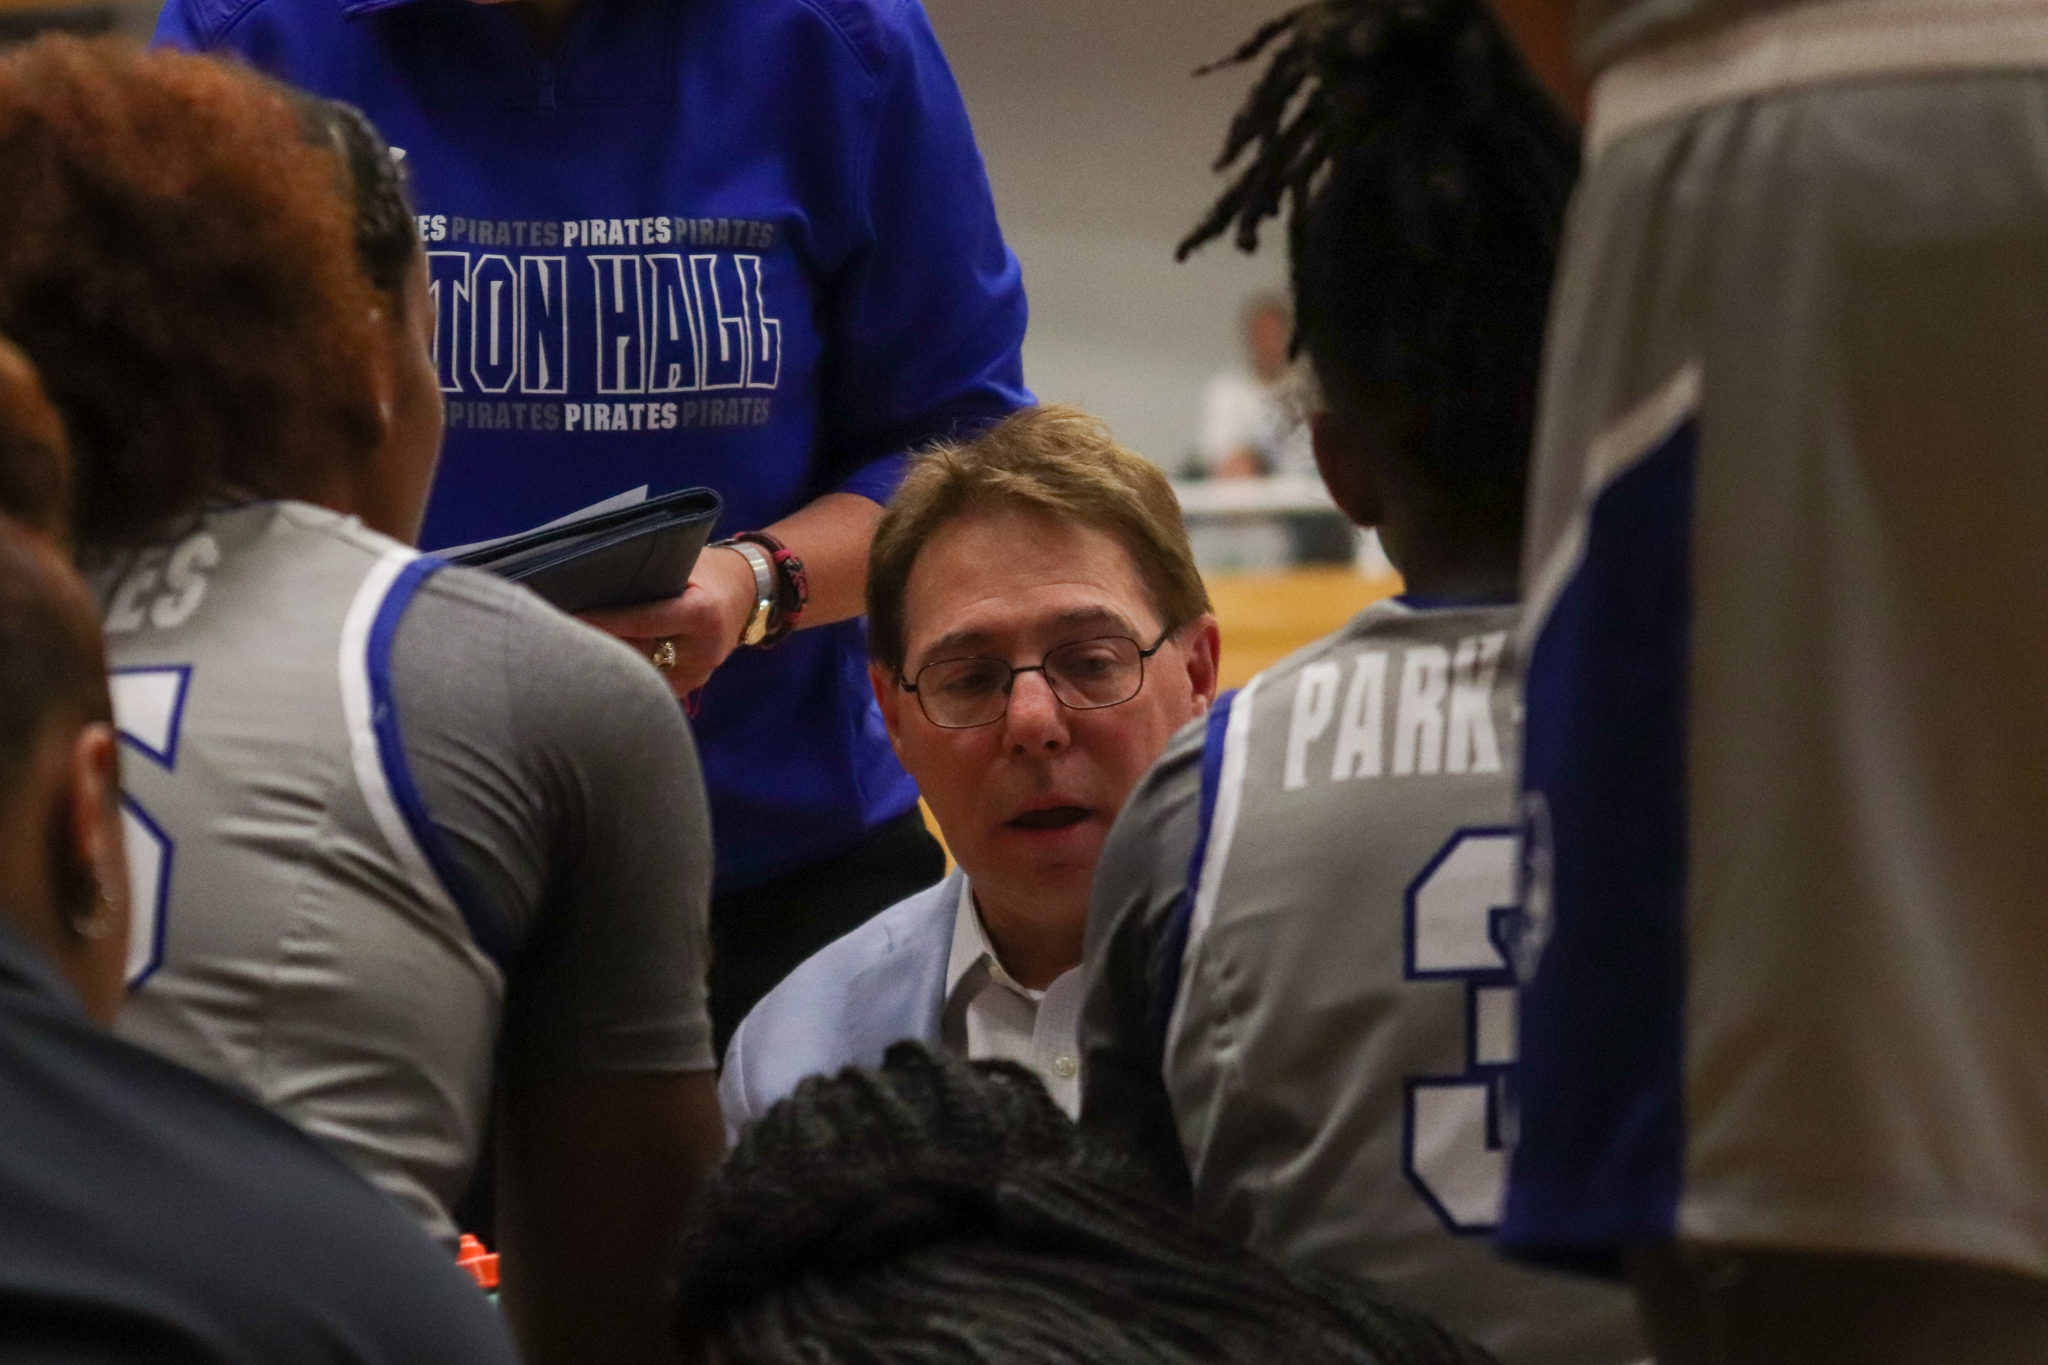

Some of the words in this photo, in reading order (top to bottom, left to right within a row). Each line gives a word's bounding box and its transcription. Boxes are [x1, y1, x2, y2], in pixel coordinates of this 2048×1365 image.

[414, 214, 447, 242] ES
[452, 216, 558, 247] PIRATES
[563, 217, 671, 247] PIRATES
[674, 217, 774, 249] PIRATES
[587, 253, 781, 394] HALL
[448, 402, 560, 430] PIRATES
[564, 403, 677, 431] PIRATES
[683, 400, 770, 428] PIRATES
[100, 530, 220, 631] ES
